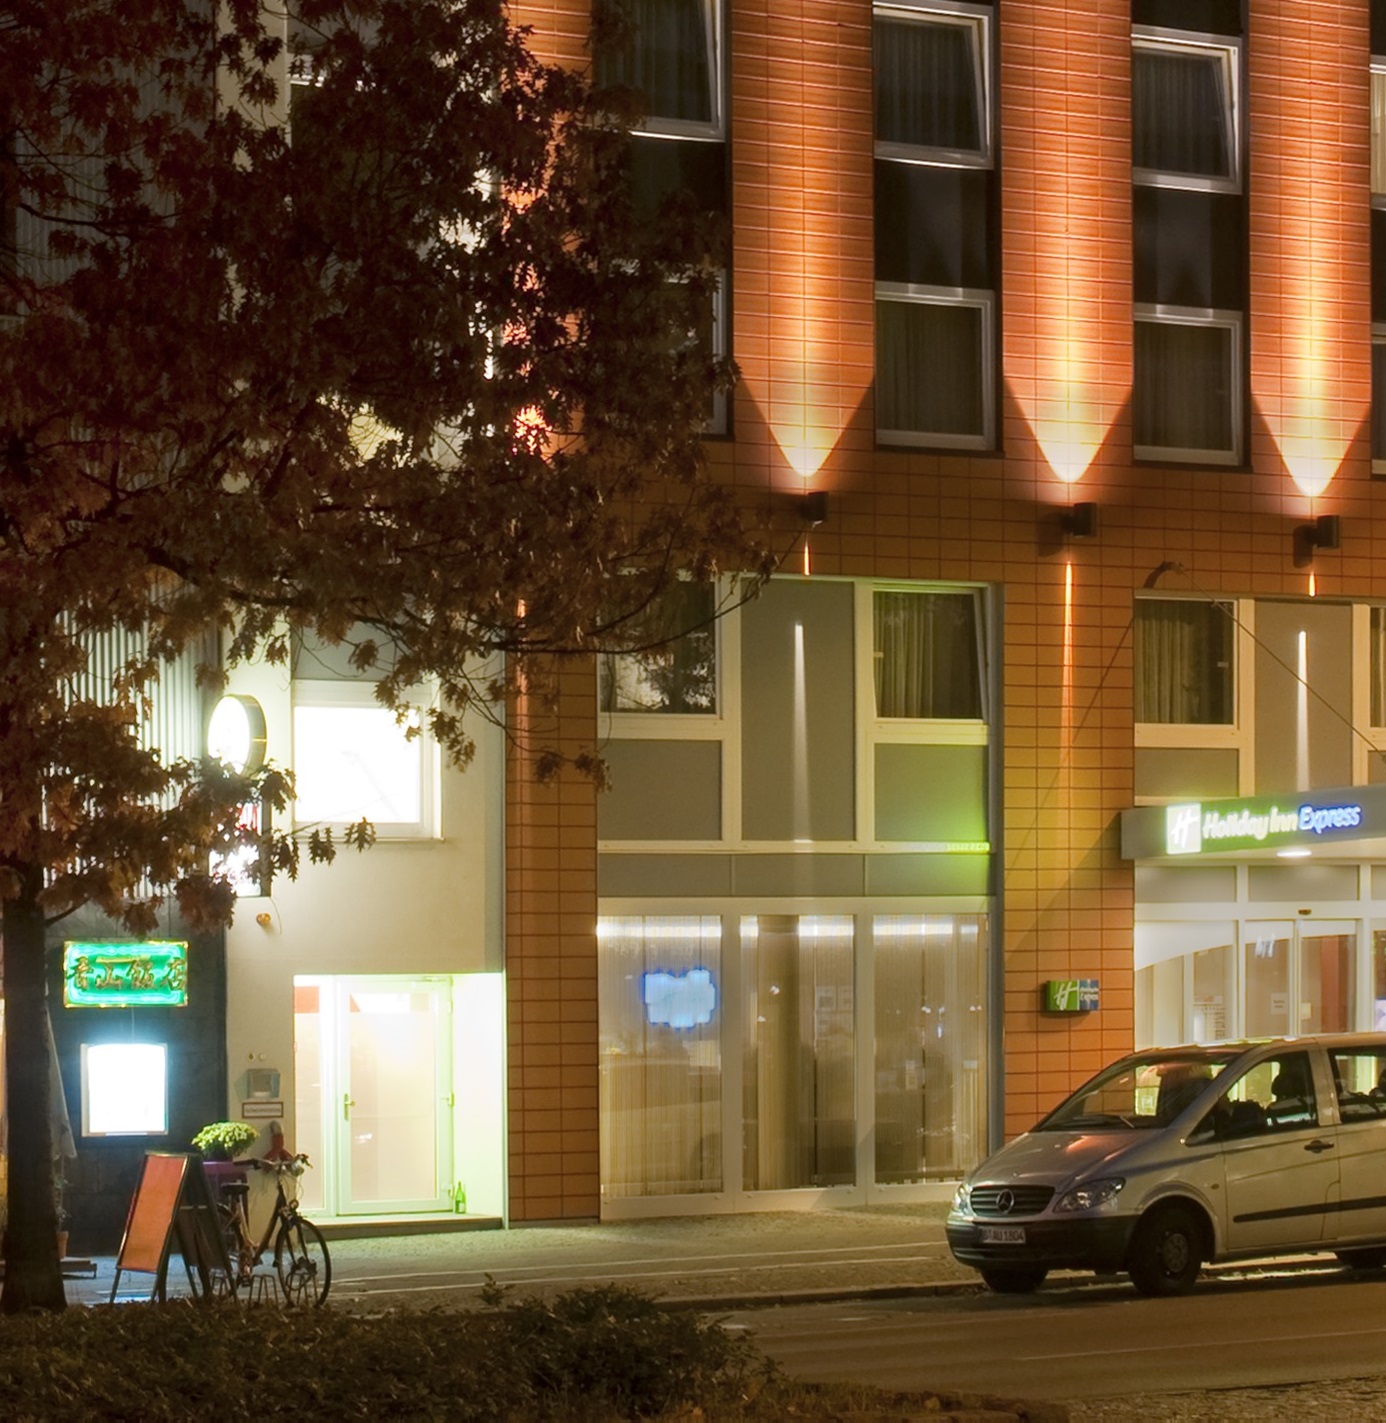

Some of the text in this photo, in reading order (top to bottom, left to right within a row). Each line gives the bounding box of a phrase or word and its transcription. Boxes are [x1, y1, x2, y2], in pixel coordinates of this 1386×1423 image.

[1203, 805, 1361, 841] Holiday Inn Express
